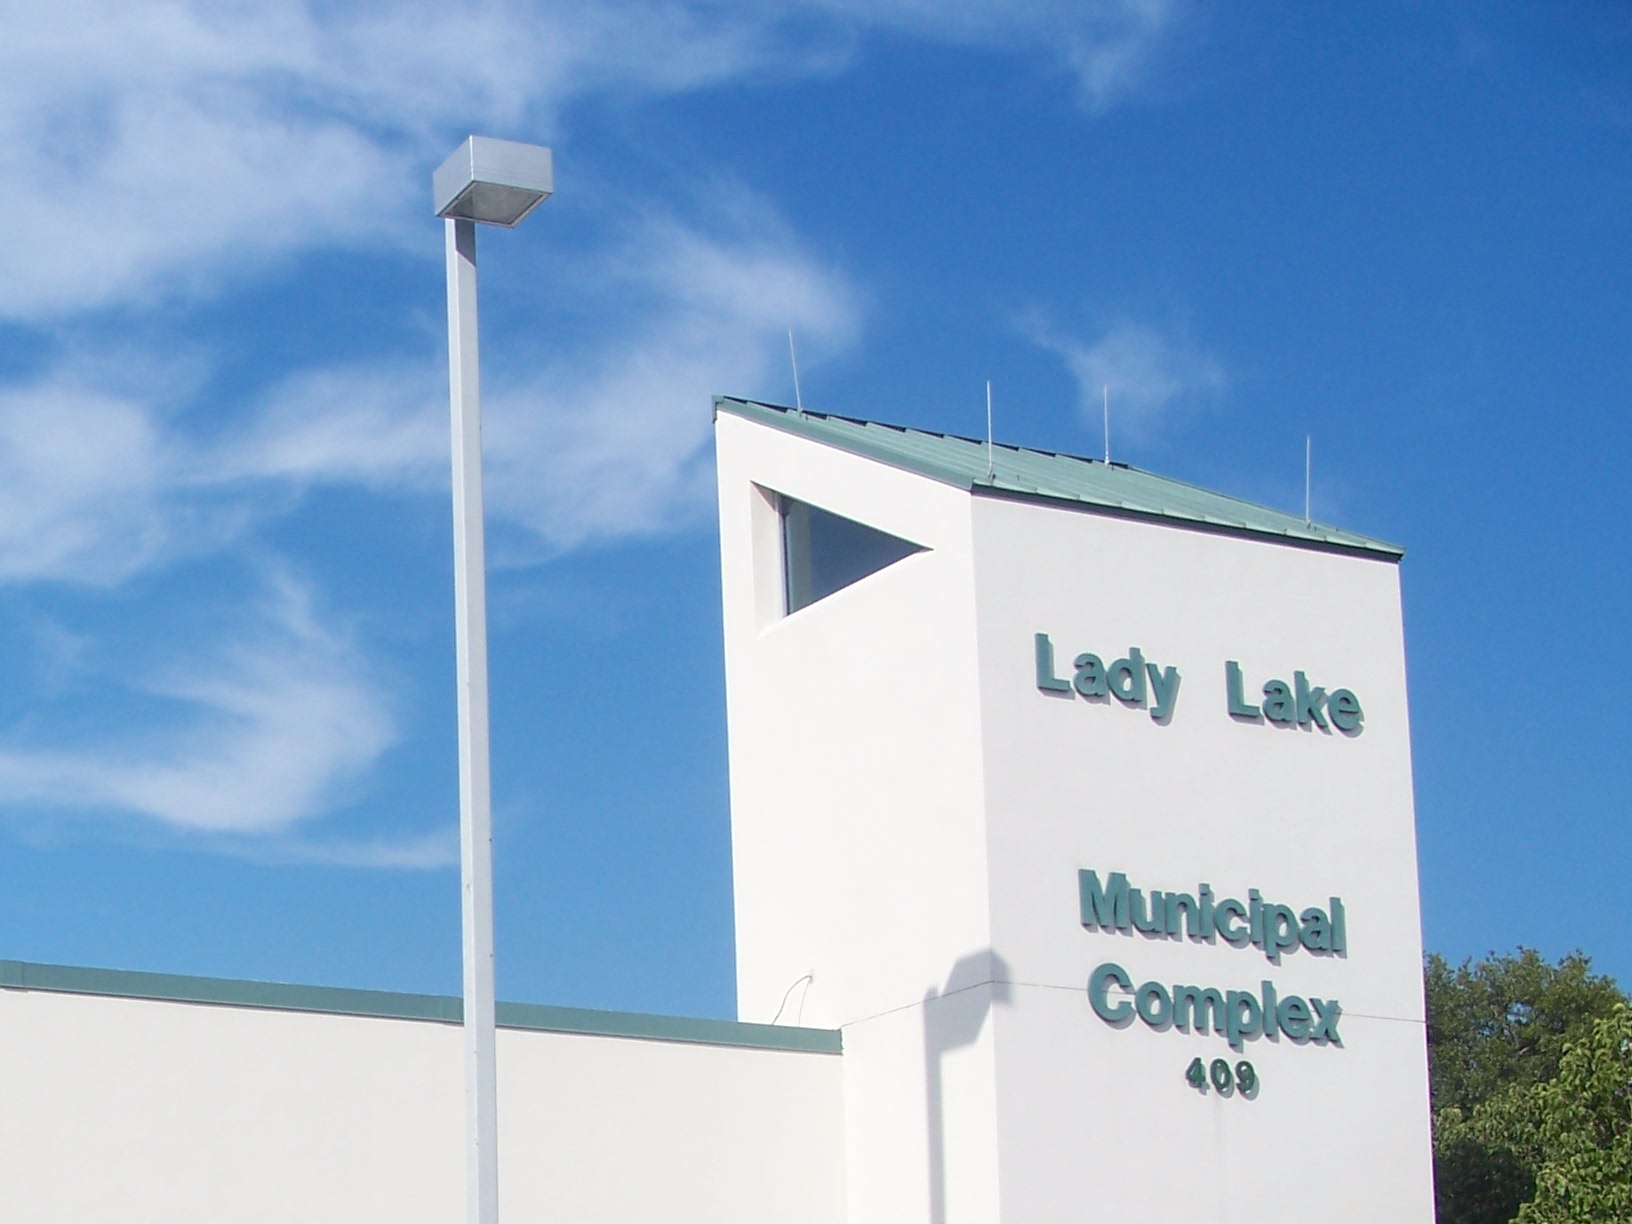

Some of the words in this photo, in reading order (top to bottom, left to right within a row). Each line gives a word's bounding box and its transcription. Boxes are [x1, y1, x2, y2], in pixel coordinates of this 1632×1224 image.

[1035, 633, 1180, 722] Lady
[1225, 660, 1362, 733] Lake
[1078, 868, 1345, 961] Municipal
[1088, 962, 1342, 1049] Complex
[1185, 1057, 1256, 1097] 409
